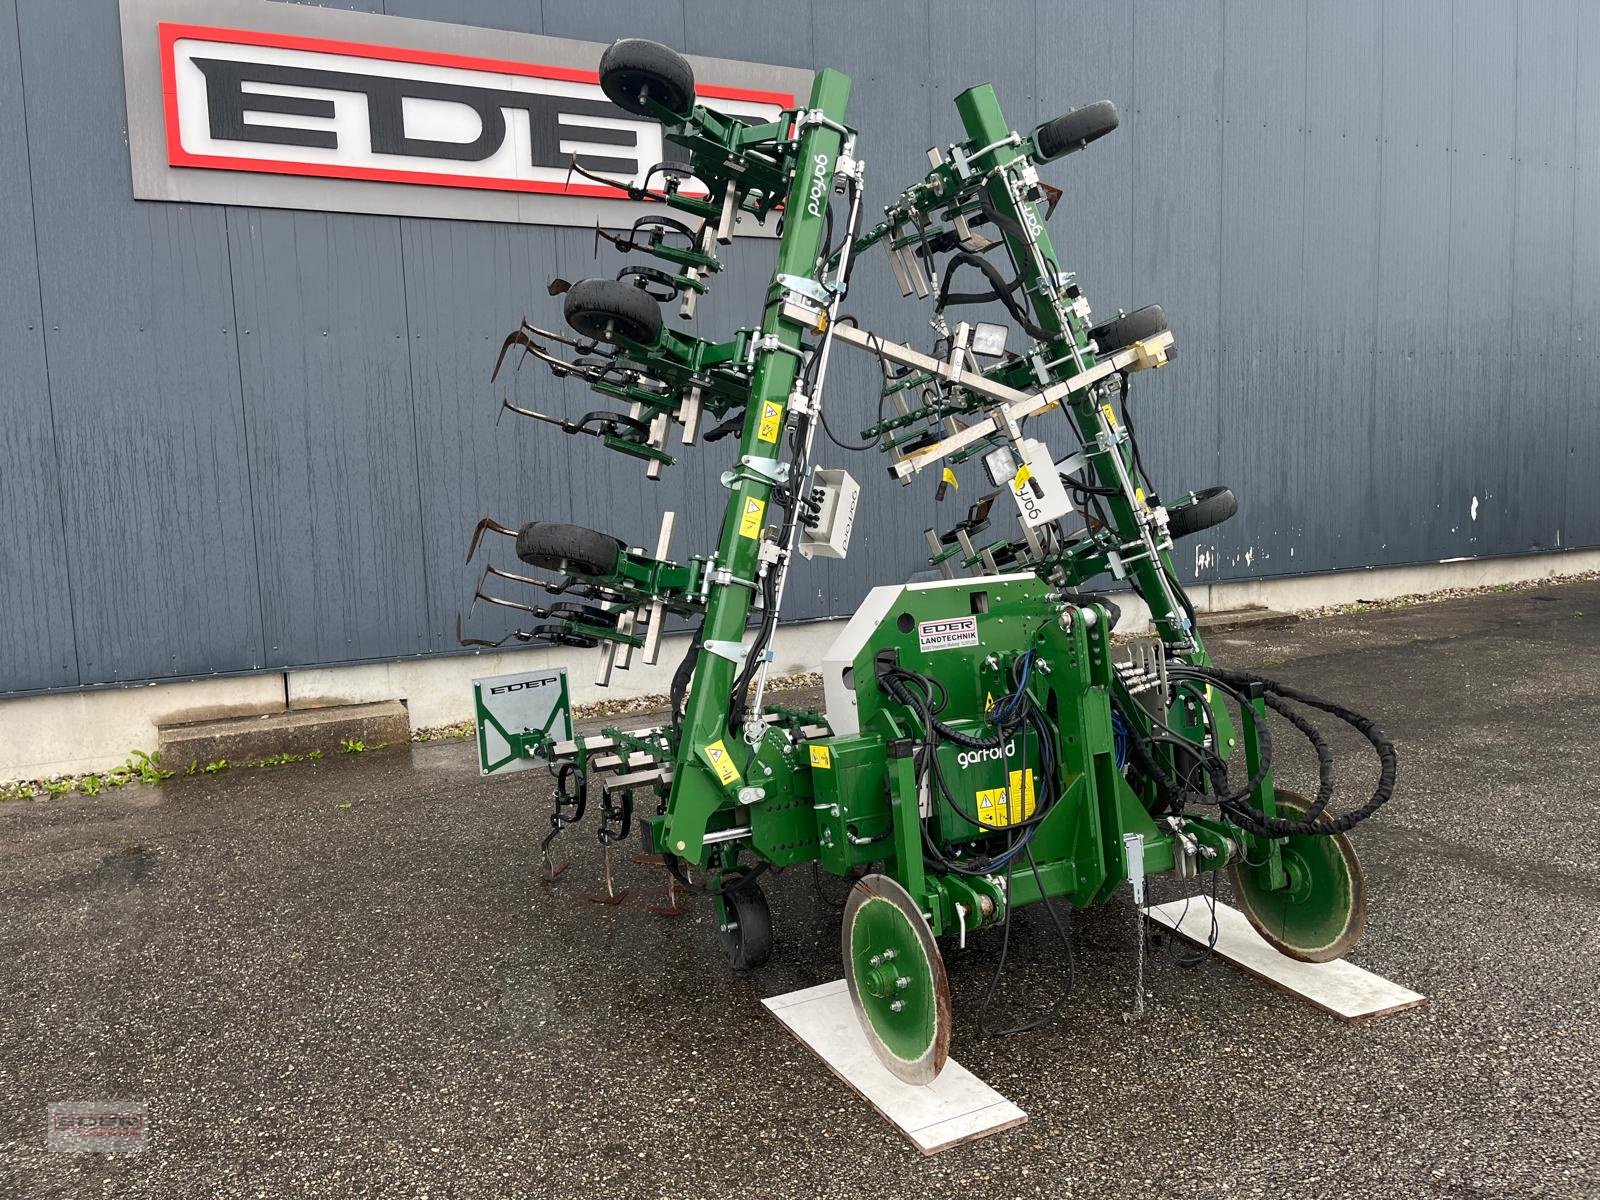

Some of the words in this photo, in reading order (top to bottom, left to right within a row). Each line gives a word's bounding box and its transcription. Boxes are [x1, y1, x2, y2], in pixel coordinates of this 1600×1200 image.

[808, 154, 828, 218] garford
[1023, 205, 1044, 237] garf
[1015, 482, 1042, 520] garf
[920, 631, 977, 645] LANDTECHNIK
[922, 620, 973, 634] EDER
